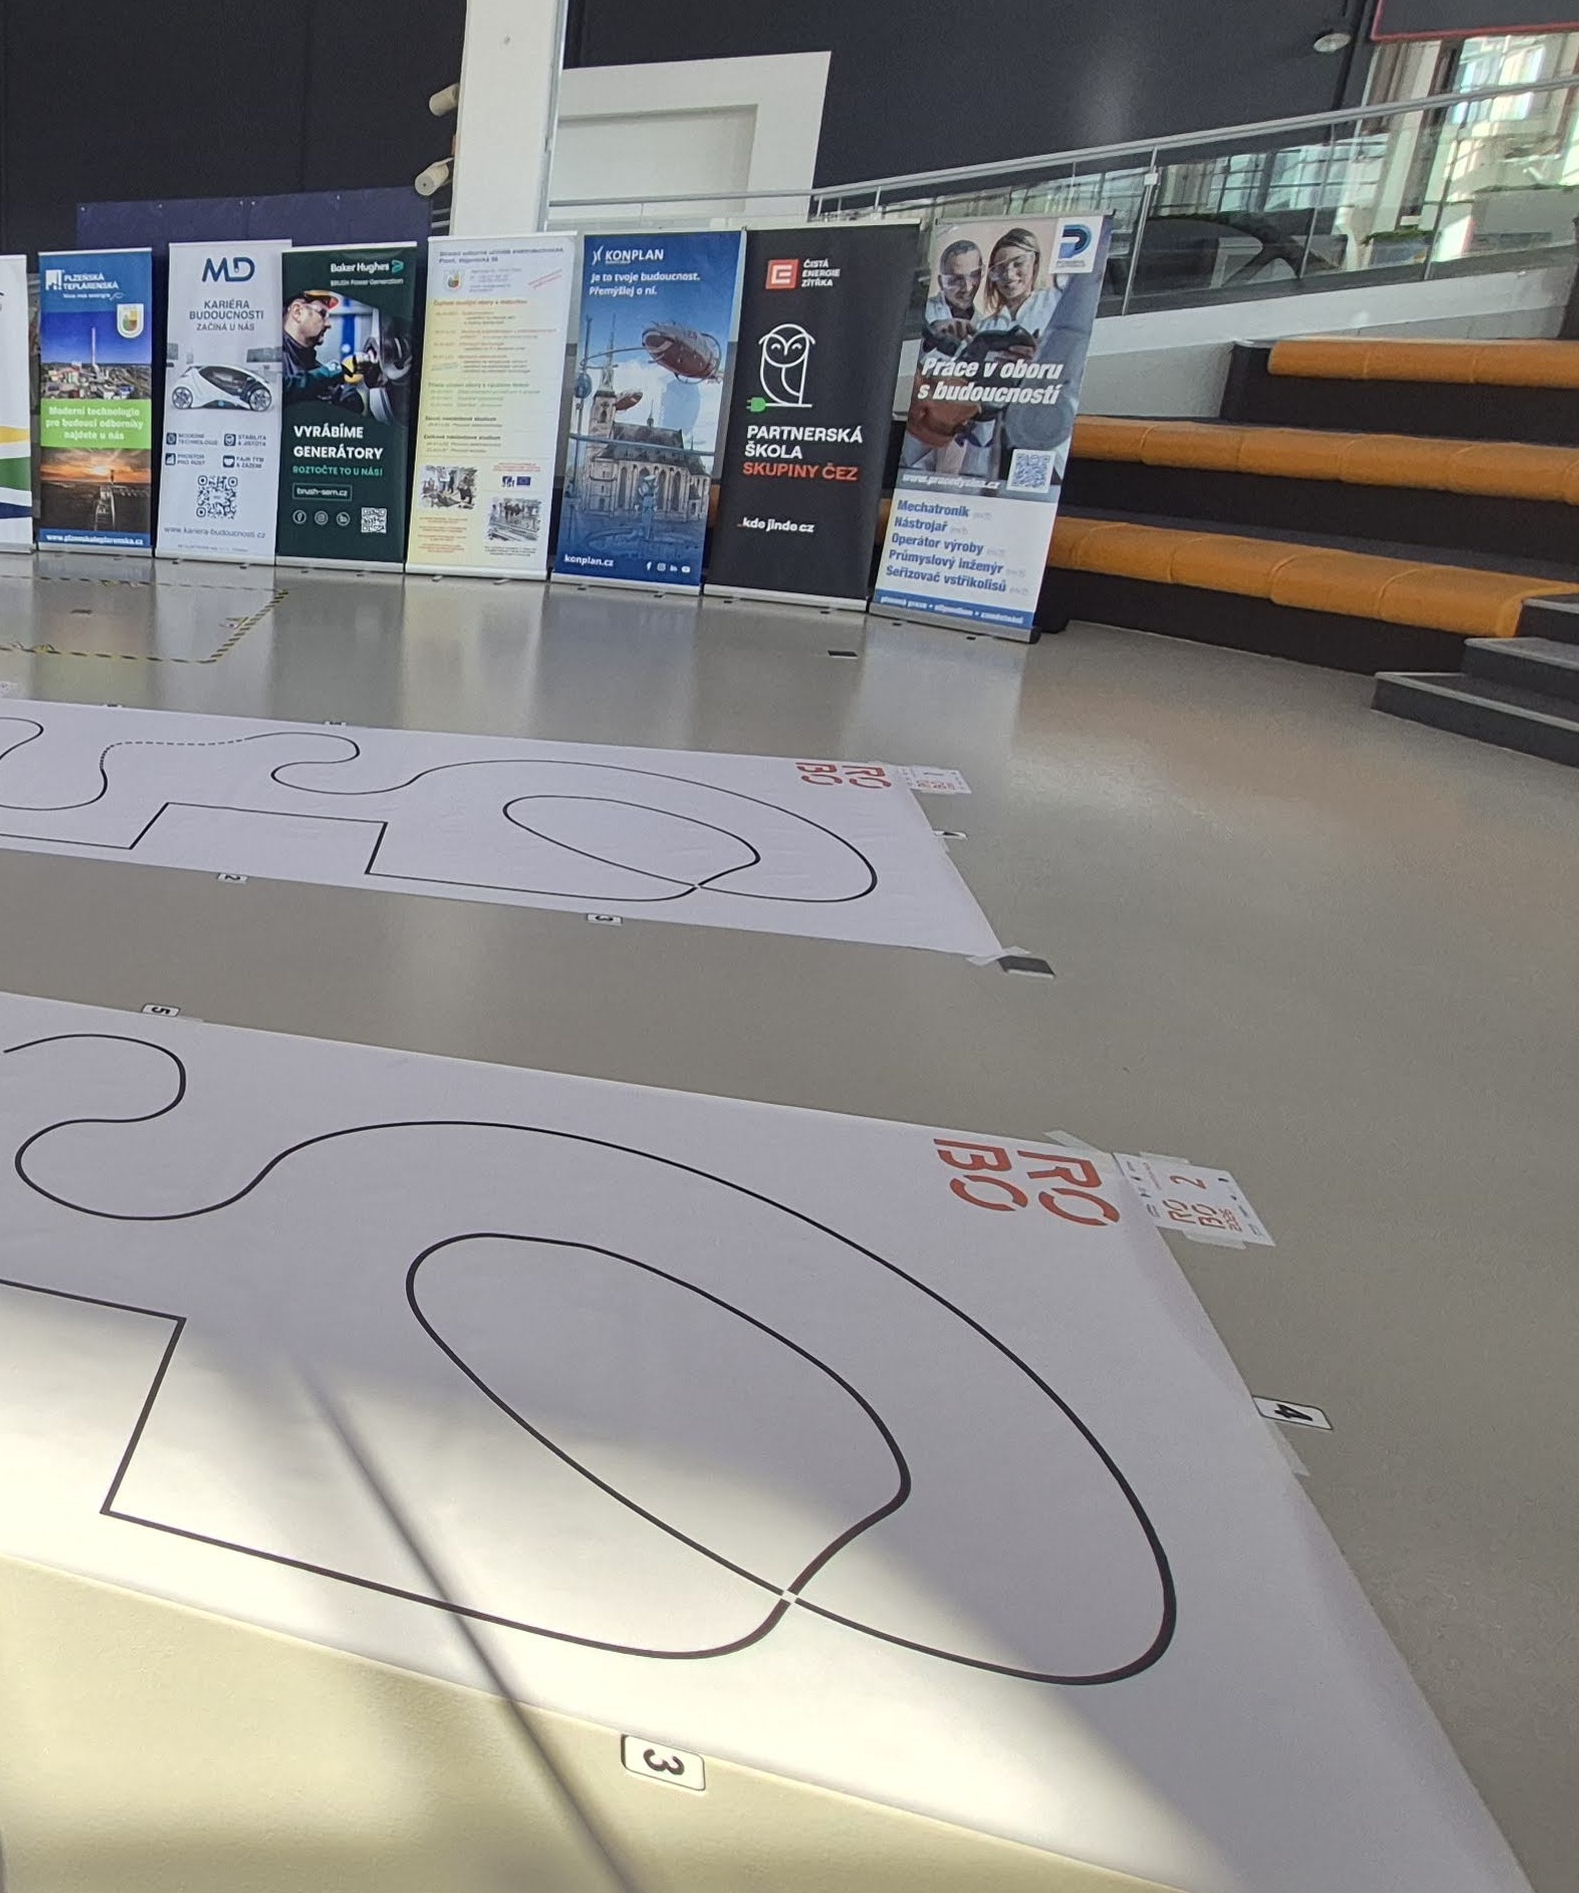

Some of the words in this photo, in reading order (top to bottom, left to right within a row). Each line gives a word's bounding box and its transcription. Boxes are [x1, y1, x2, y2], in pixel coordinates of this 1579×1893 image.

[605, 249, 664, 264] KONPLAN
[803, 258, 829, 268] ČISTÁ
[202, 256, 255, 282] MD
[330, 264, 356, 273] Baker
[356, 261, 390, 274] Hughes
[802, 268, 840, 277] ENERGIE
[63, 272, 105, 282] PLZEŇSKÁ
[591, 273, 601, 283] Je
[603, 273, 613, 281] to
[615, 272, 639, 283] tvoje
[641, 271, 701, 281] budoucnost.
[589, 286, 634, 297] Přemýšlej
[645, 285, 658, 295] ní.
[204, 299, 250, 309] KARIÉRA
[189, 310, 264, 320] BUDOUCNOSTI
[230, 323, 235, 331] U
[238, 321, 255, 331] NÁS
[922, 358, 979, 377] Práce
[983, 364, 997, 377] v
[1000, 359, 1063, 380] oboru
[918, 386, 930, 399] s
[932, 382, 1062, 405] budoucností
[45, 419, 61, 428] pro
[294, 422, 364, 439] VYRÁBÍME
[63, 430, 98, 441] najdete
[108, 430, 125, 440] nás
[746, 425, 863, 443] PARTNERSKÁ
[293, 443, 384, 460] GENERÁTORY
[744, 441, 803, 459] ŠKOLA
[292, 465, 338, 475] ROZTOČTE
[340, 467, 352, 475] TO
[353, 467, 359, 475] U
[361, 466, 383, 476] NÁS!
[743, 462, 820, 478] SKUPINY
[822, 462, 858, 480] ČEZ
[296, 487, 348, 496] brush-sem.cz
[897, 500, 970, 518] Mechatronik
[894, 516, 949, 533] Nástrojař
[891, 533, 941, 549] Operátor
[943, 539, 984, 556] výroby
[564, 554, 614, 566] konplan.cz
[889, 549, 955, 569] Průmyslový
[958, 560, 1004, 576] inženýr
[886, 565, 940, 584] Seřizovač
[943, 576, 1007, 593] vstřikolisů
[795, 762, 843, 786] BO
[842, 765, 892, 789] RO
[151, 1006, 171, 1015] 5
[933, 1138, 1029, 1212] BO
[1170, 1175, 1207, 1190] 2
[1017, 1150, 1120, 1226] RO
[1162, 1199, 1196, 1224] RO
[1191, 1203, 1226, 1229] BO
[1273, 1403, 1313, 1422] 4
[643, 1748, 685, 1775] 3
